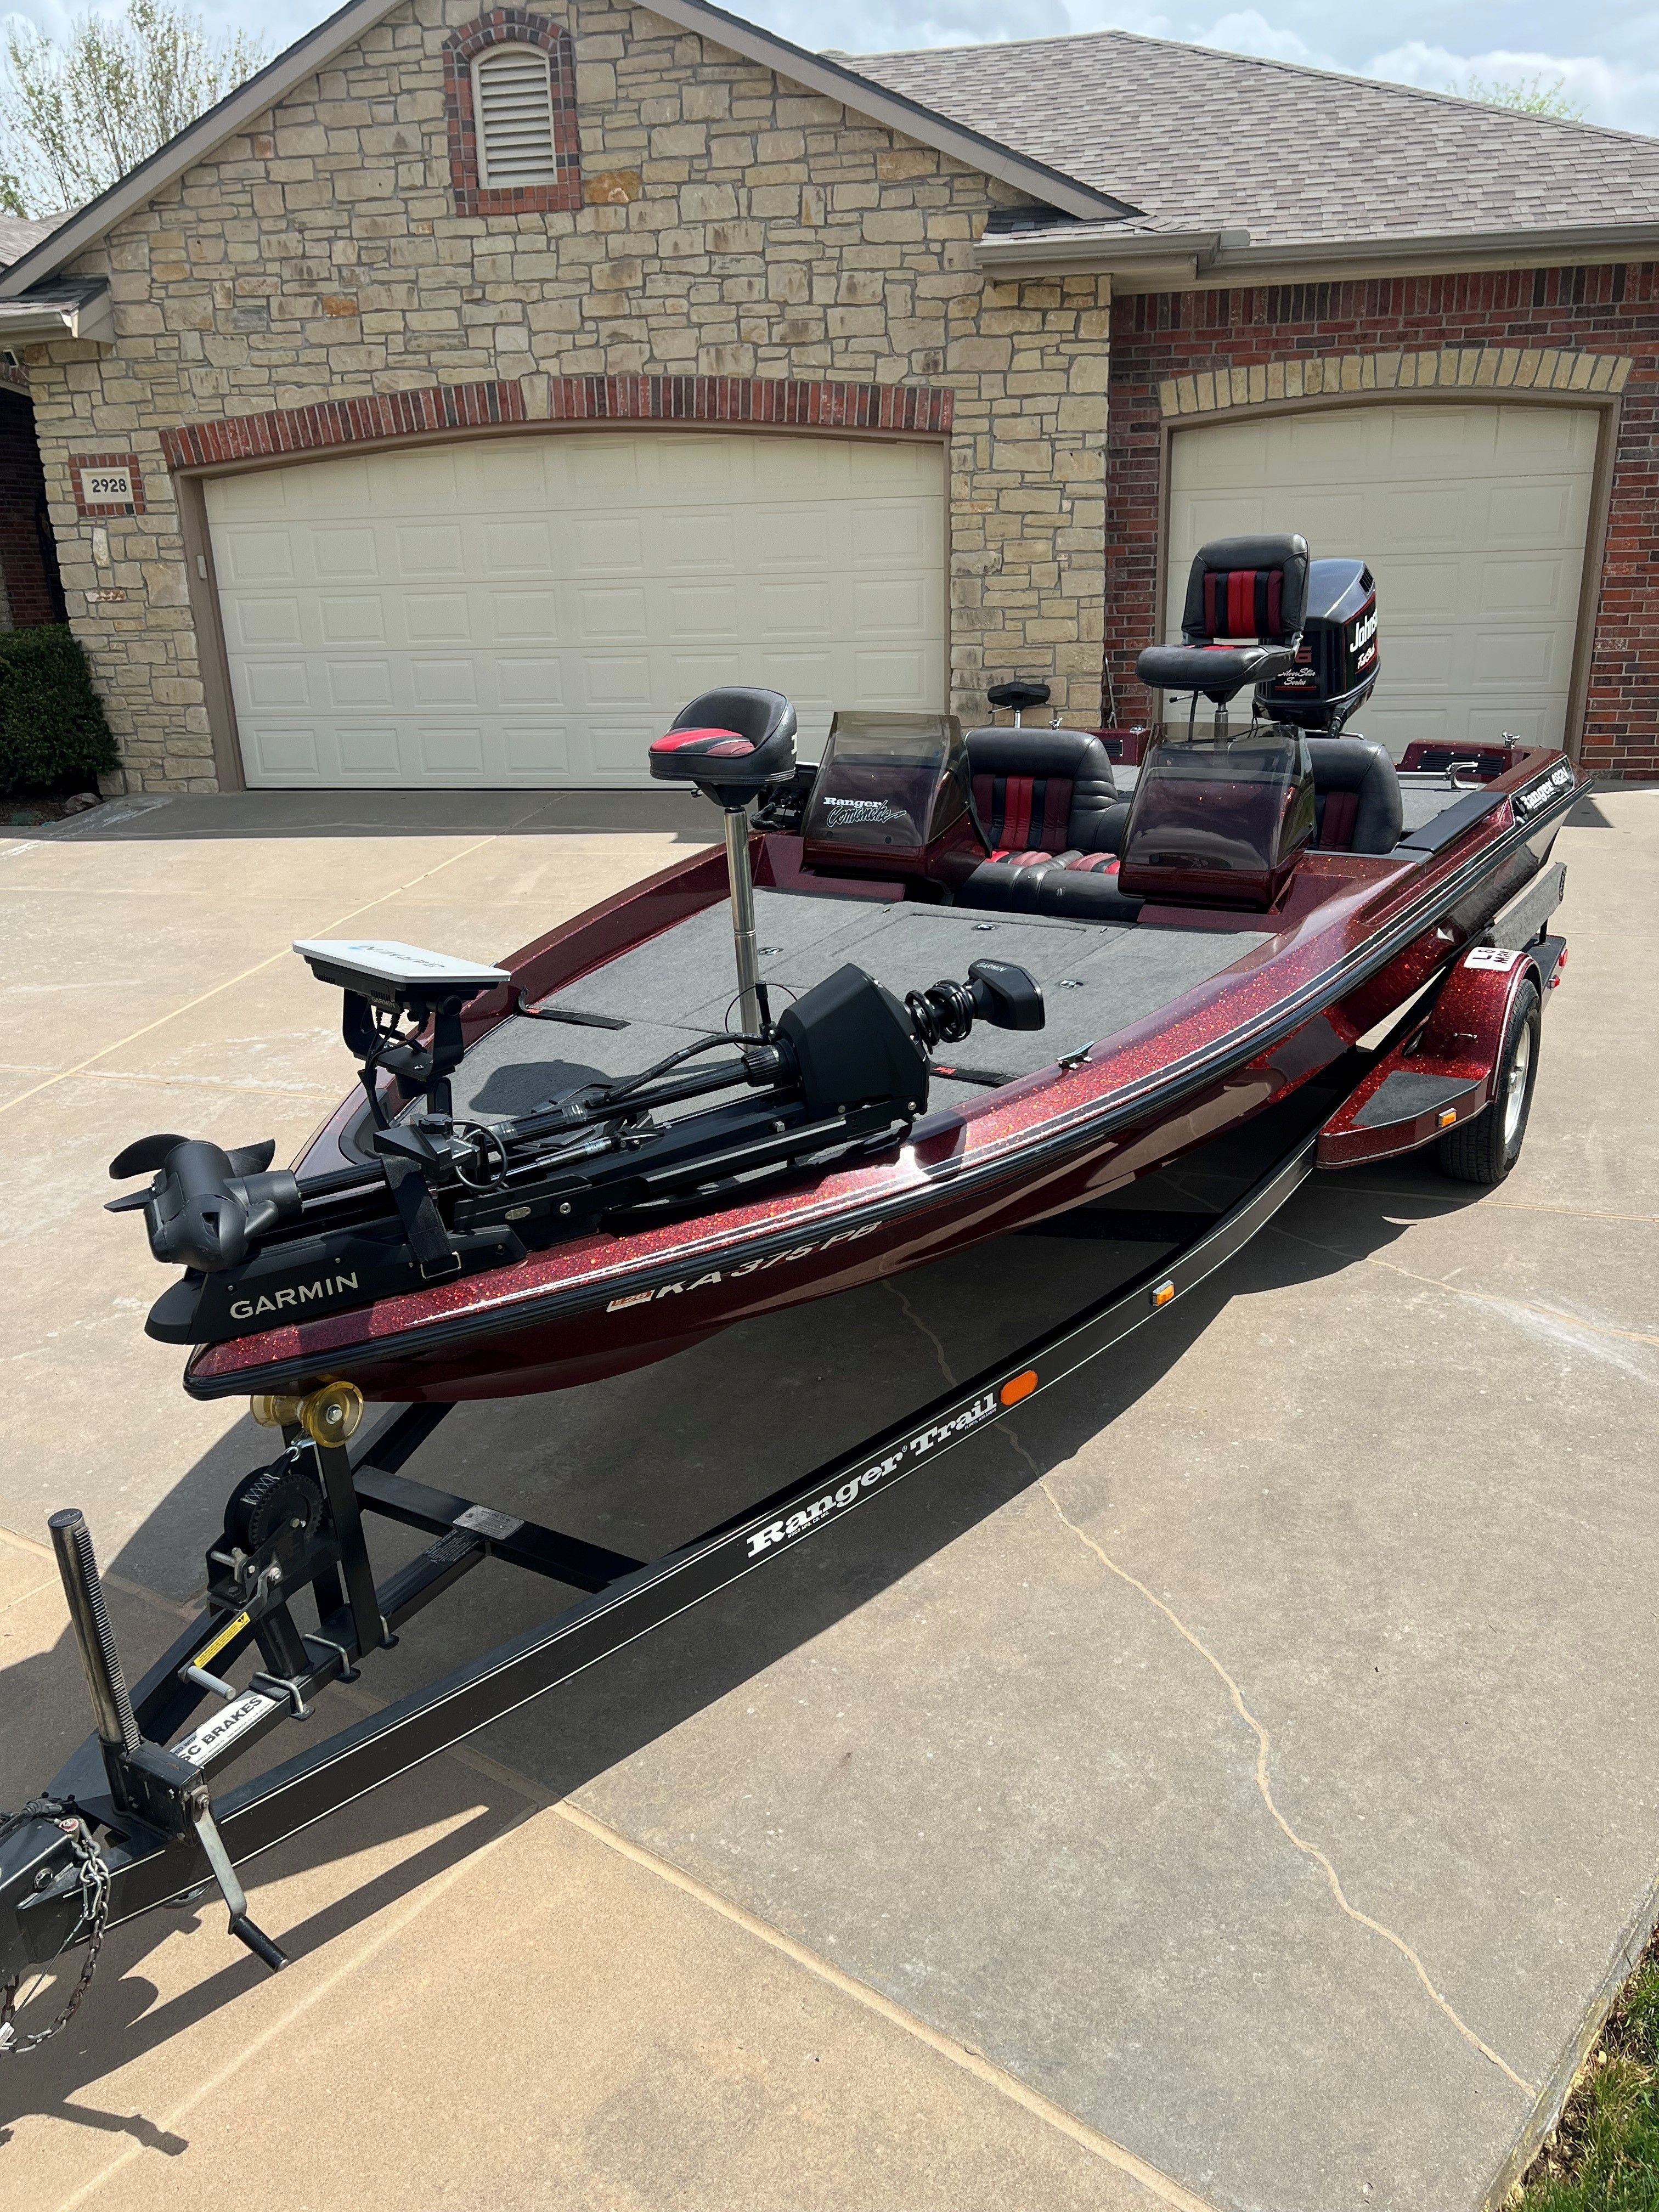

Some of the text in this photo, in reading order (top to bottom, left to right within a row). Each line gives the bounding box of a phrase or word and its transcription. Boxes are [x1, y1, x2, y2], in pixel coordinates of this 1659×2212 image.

[92, 478, 127, 493] 2928
[1277, 668, 1316, 676] ilverStar
[1284, 676, 1306, 685] Series
[823, 797, 882, 808] Ranger
[1520, 777, 1553, 809] Ranger
[827, 799, 906, 827] Comanche
[976, 962, 1007, 972] GARMIN
[656, 1271, 722, 1299] KA
[730, 1241, 820, 1277] 375
[230, 1272, 358, 1319] GARMIN
[910, 1392, 997, 1456] Trail
[787, 1528, 801, 1538] WOOD
[201, 1697, 262, 1745] BRAKES
